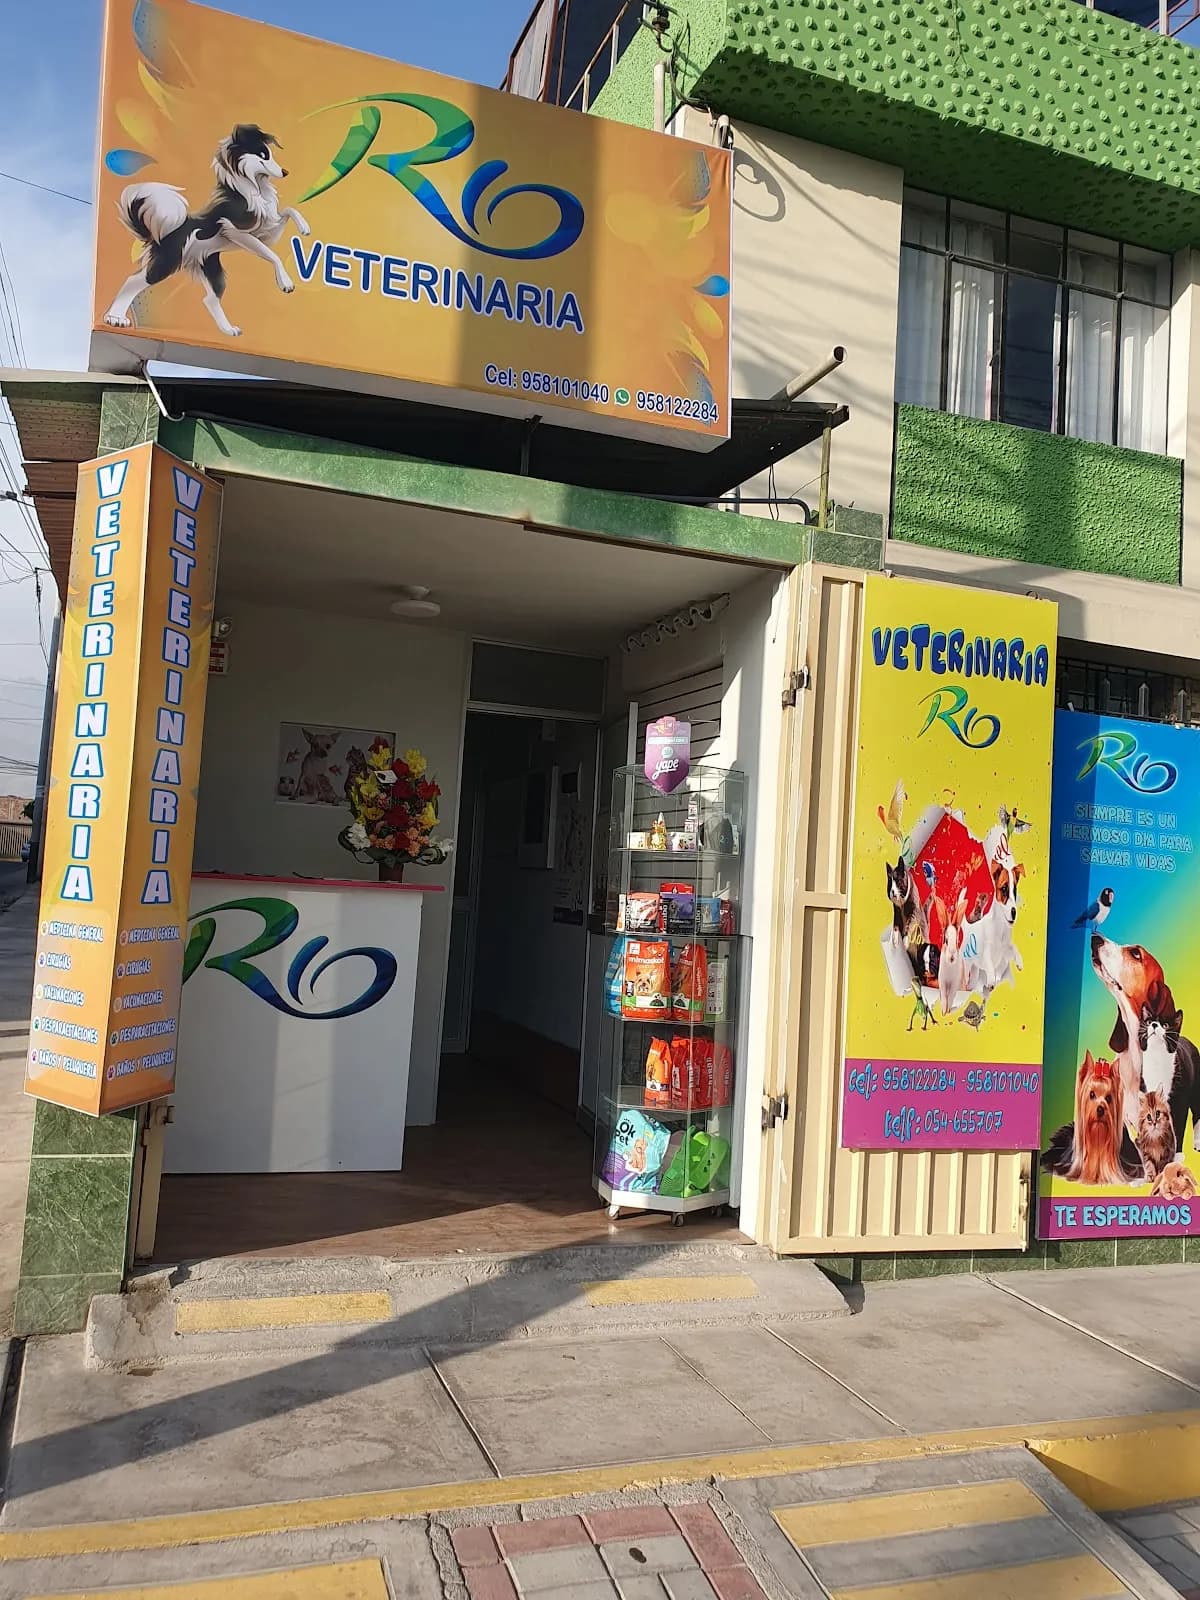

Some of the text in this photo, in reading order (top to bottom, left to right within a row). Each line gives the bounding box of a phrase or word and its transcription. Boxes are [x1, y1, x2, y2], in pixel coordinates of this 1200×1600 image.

[290, 235, 585, 334] VETERINARIA
[484, 364, 719, 422] Cel: 958101040 958122284
[871, 623, 1049, 687] VETERINARIA
[60, 459, 129, 902] VETERINARIA
[140, 466, 204, 904] VETERINARIA
[652, 758, 679, 780] yape
[1074, 801, 1177, 830] SIEMPRE ES UN
[1062, 822, 1131, 845] HERMOSO
[1158, 833, 1193, 853] PARA
[1080, 847, 1177, 873] SALVAR VIDAS
[78, 924, 104, 942] GENERAL
[882, 1066, 956, 1092] 958122284
[619, 1121, 637, 1138] Ok
[923, 1108, 1004, 1136] 054-655707
[1053, 1203, 1193, 1228] TE ESPERAMOS
